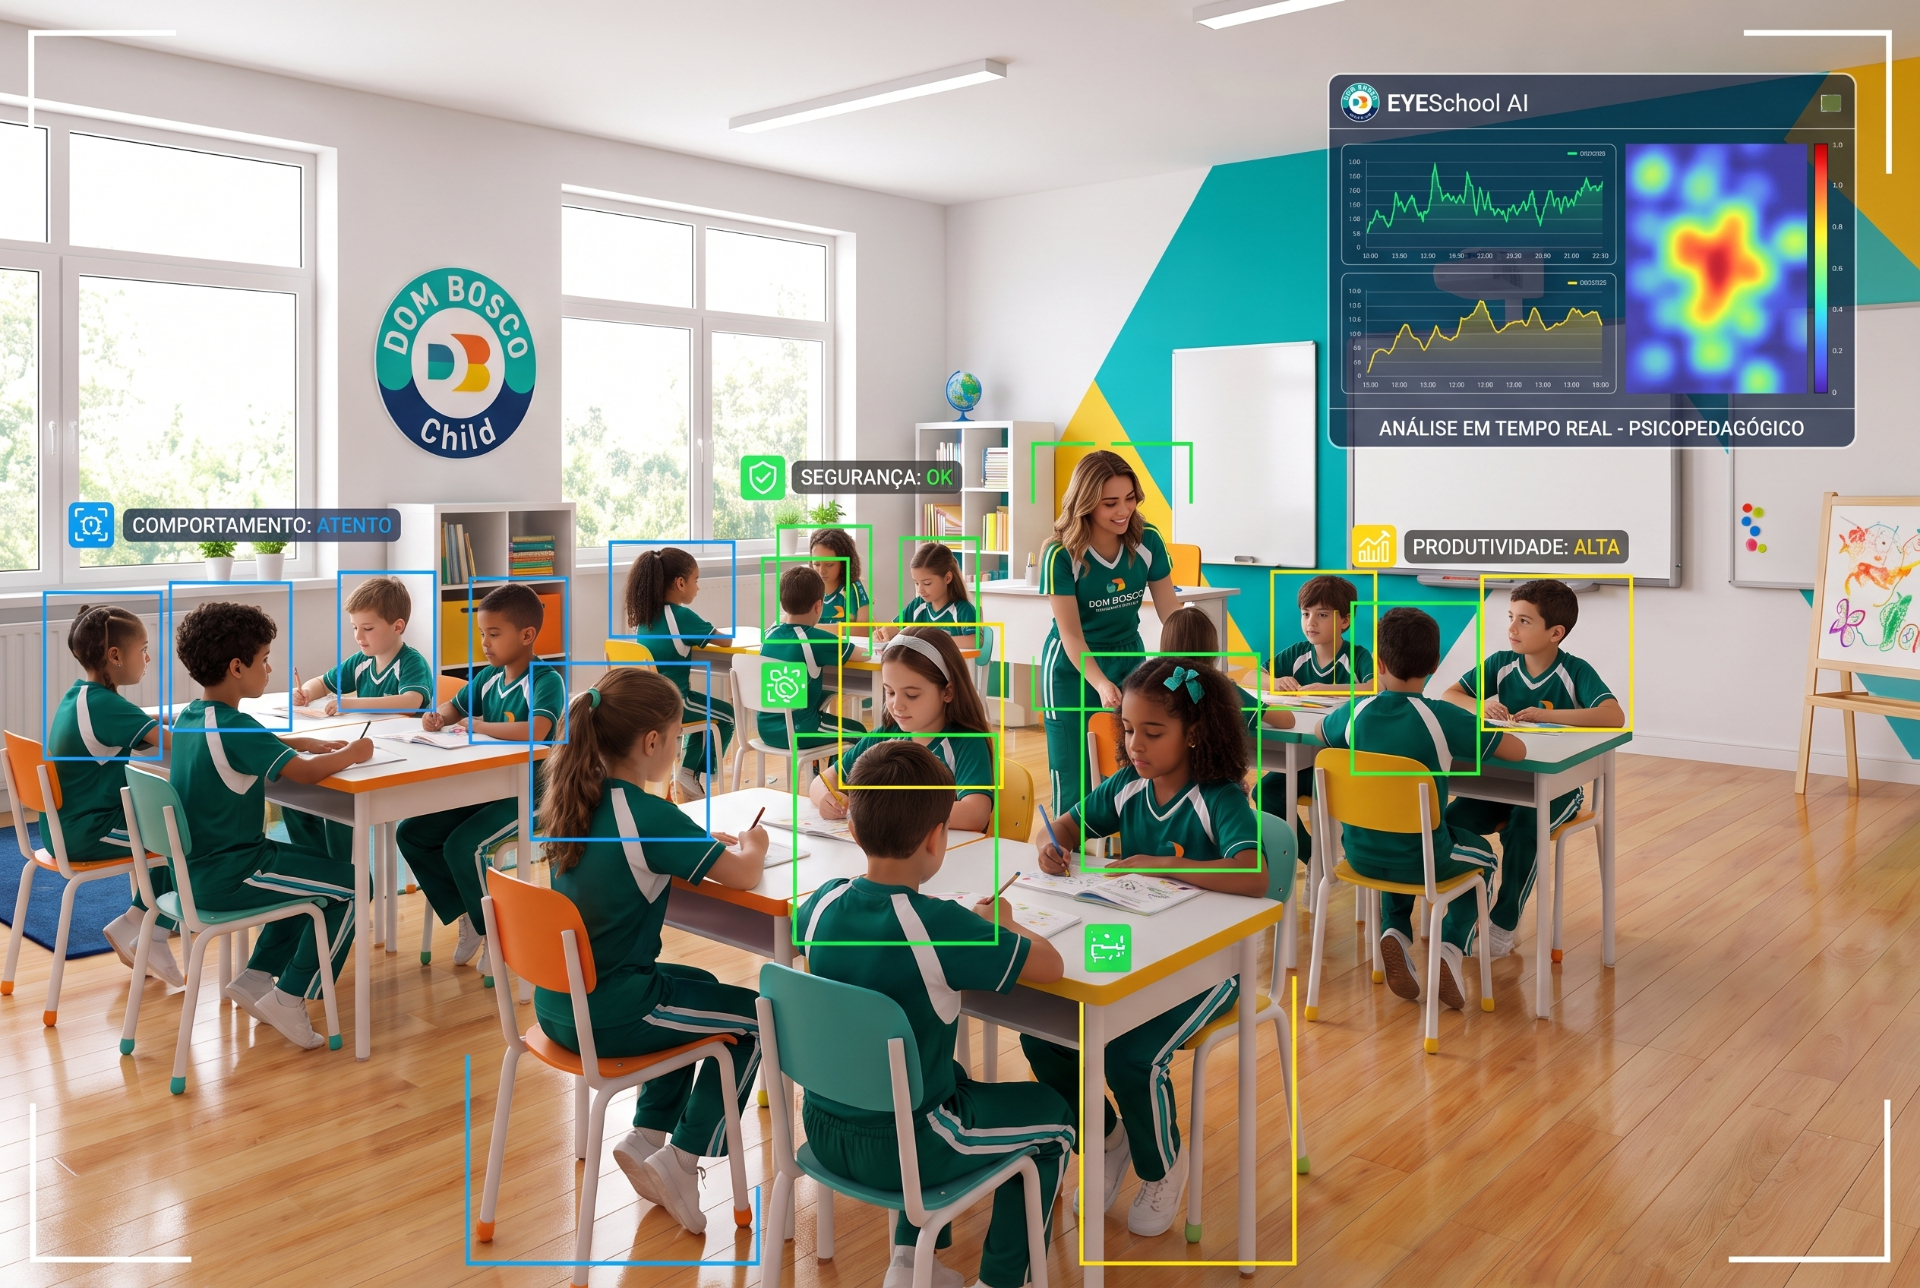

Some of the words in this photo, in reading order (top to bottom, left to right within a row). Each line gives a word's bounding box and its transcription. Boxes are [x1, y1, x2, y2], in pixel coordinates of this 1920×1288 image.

[383, 282, 439, 355] DOM
[447, 275, 529, 359] BOSCO
[420, 416, 497, 451] Child
[1089, 598, 1110, 608] DOM
